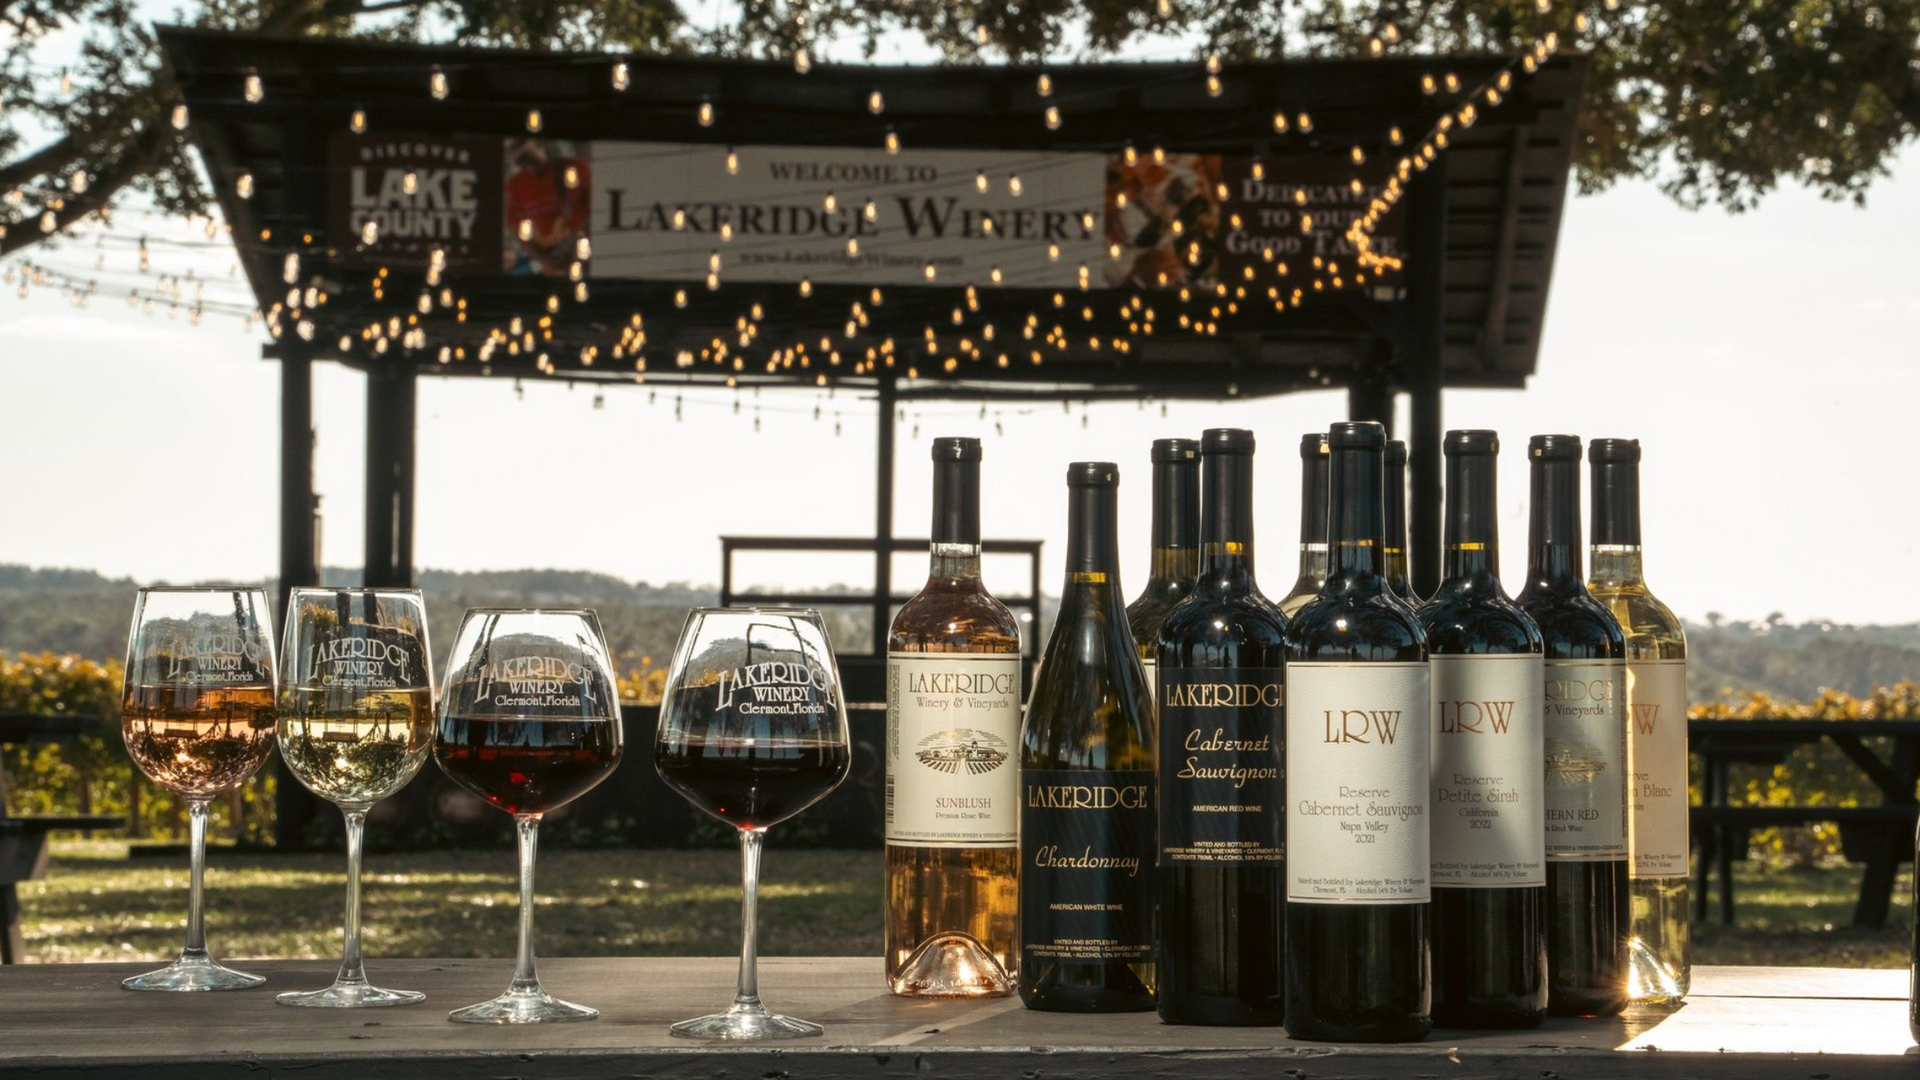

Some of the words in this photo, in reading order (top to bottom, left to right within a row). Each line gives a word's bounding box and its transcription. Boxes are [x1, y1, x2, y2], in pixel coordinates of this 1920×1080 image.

[361, 143, 470, 164] DISCOVER
[770, 162, 900, 183] WELCOME
[905, 163, 939, 183] TO
[351, 167, 479, 209] LAKE
[350, 208, 478, 240] COUNTY
[605, 188, 880, 238] LAKERIDGE
[896, 195, 1100, 241] WINERY
[167, 635, 265, 679] LAKERIDGE
[198, 656, 243, 671] WINERY
[305, 637, 411, 686] LAKERIDGE
[334, 660, 385, 676] WINERY
[474, 655, 598, 704] LAKERIDGE
[509, 681, 565, 695] WINERY
[715, 661, 838, 711] LAKERIDGE
[909, 672, 1015, 695] LAKERIDGE
[752, 686, 810, 702] WINERY
[916, 697, 950, 712] Winery
[953, 697, 964, 708] &
[967, 697, 1010, 712] Vineyards
[1439, 701, 1515, 734] LRW
[1555, 703, 1605, 719] Vineyards
[1323, 709, 1402, 745] LRW
[1185, 728, 1270, 752] Cabernet
[1177, 756, 1278, 789] Sauvignon
[1454, 773, 1504, 786] Reserve
[1028, 785, 1148, 810] LAKERIDGE
[1339, 786, 1390, 798] Reserve
[1438, 788, 1482, 803] Petite
[1486, 788, 1519, 803] Sirah
[1643, 783, 1673, 798] Blanc
[936, 797, 992, 809] SUNBLUSH
[1299, 800, 1361, 817] Cabernet
[1366, 800, 1424, 822] Sauvignon
[1459, 807, 1499, 818] California
[1470, 820, 1492, 830] 2022
[1577, 809, 1599, 820] RED
[1340, 821, 1362, 833] Napa
[1364, 821, 1389, 834] Valley
[1355, 834, 1376, 844] 2021
[1035, 845, 1140, 878] Chardonnay
